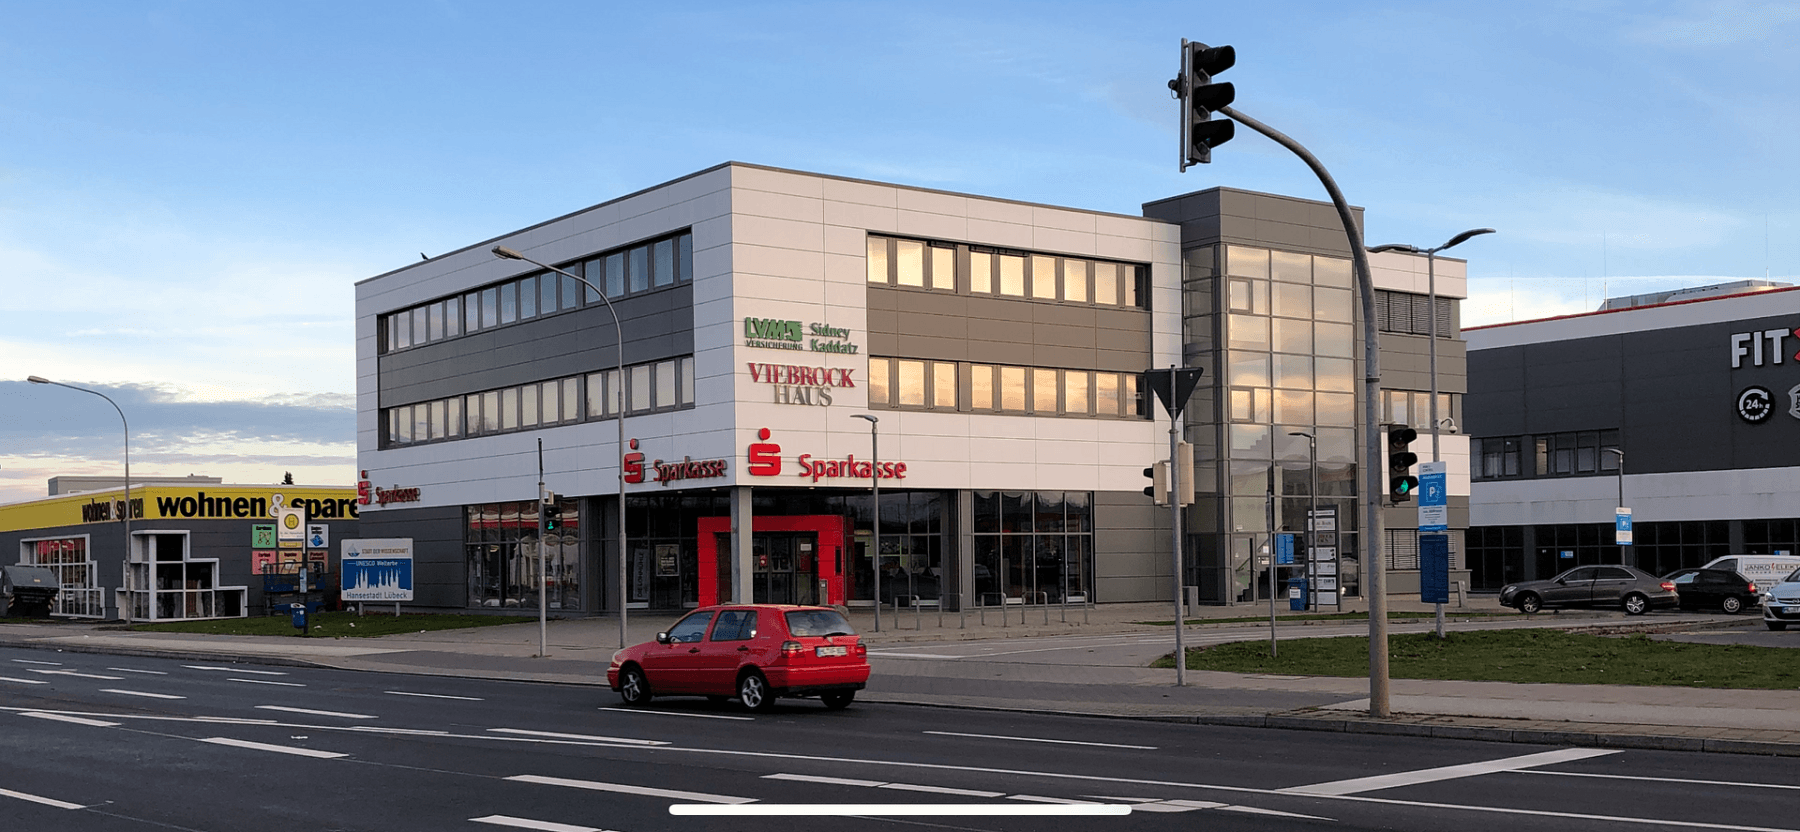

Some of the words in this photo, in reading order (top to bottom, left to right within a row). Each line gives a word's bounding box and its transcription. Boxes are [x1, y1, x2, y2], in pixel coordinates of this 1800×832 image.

[809, 322, 850, 341] Sidney
[746, 339, 803, 351] VERSICHERUNG
[811, 338, 859, 355] Kaddatz
[1731, 327, 1800, 368] FIT
[747, 362, 857, 388] VIEBROCK
[773, 384, 833, 407] HAUS
[653, 456, 728, 486] Sparkasse
[799, 454, 907, 483] Sparkasse
[156, 491, 267, 518] wohnen
[375, 484, 421, 507] Sparkasse
[82, 498, 110, 523] wohnen
[116, 498, 144, 523] spren
[346, 591, 383, 599] Hansestadt
[384, 590, 408, 600] Lübeck
